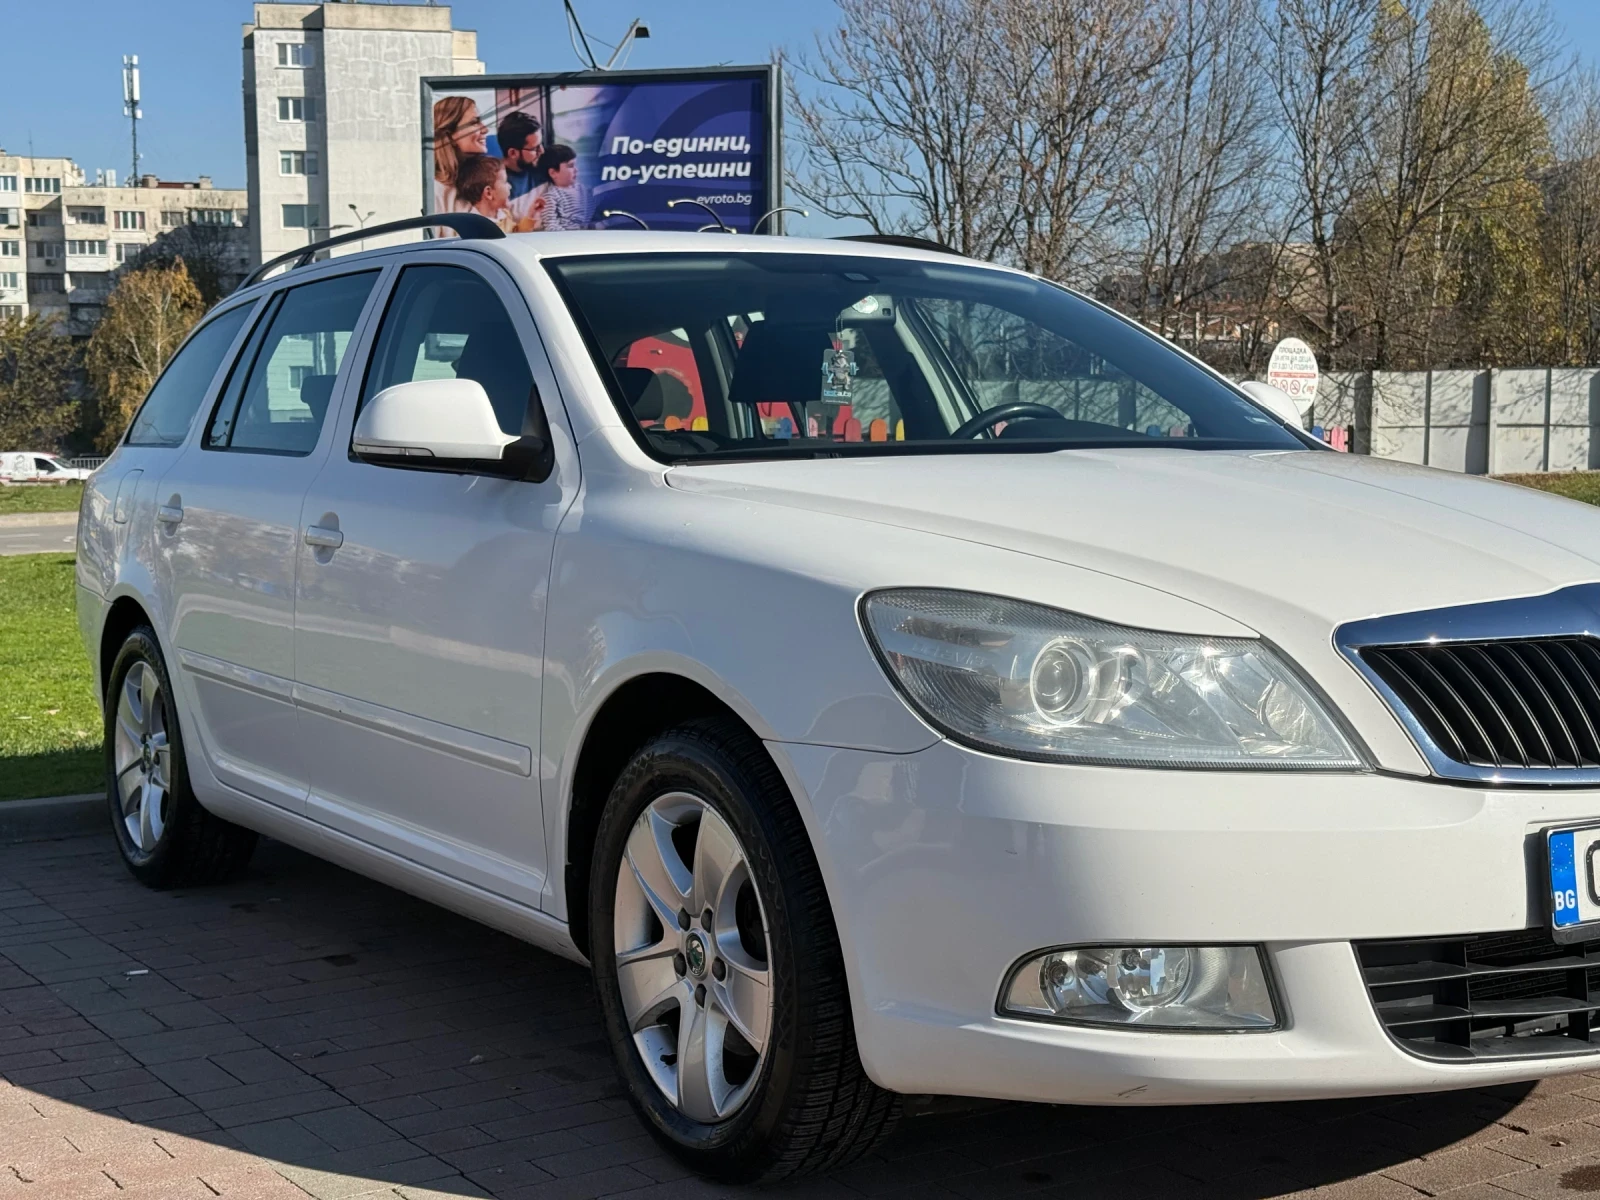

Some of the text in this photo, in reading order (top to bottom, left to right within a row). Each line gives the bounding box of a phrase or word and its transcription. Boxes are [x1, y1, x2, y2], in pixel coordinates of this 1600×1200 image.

[611, 136, 751, 158] По-единни,
[601, 162, 751, 185] по-успешни
[696, 193, 752, 205] evroto.bg
[1554, 889, 1576, 911] BG
